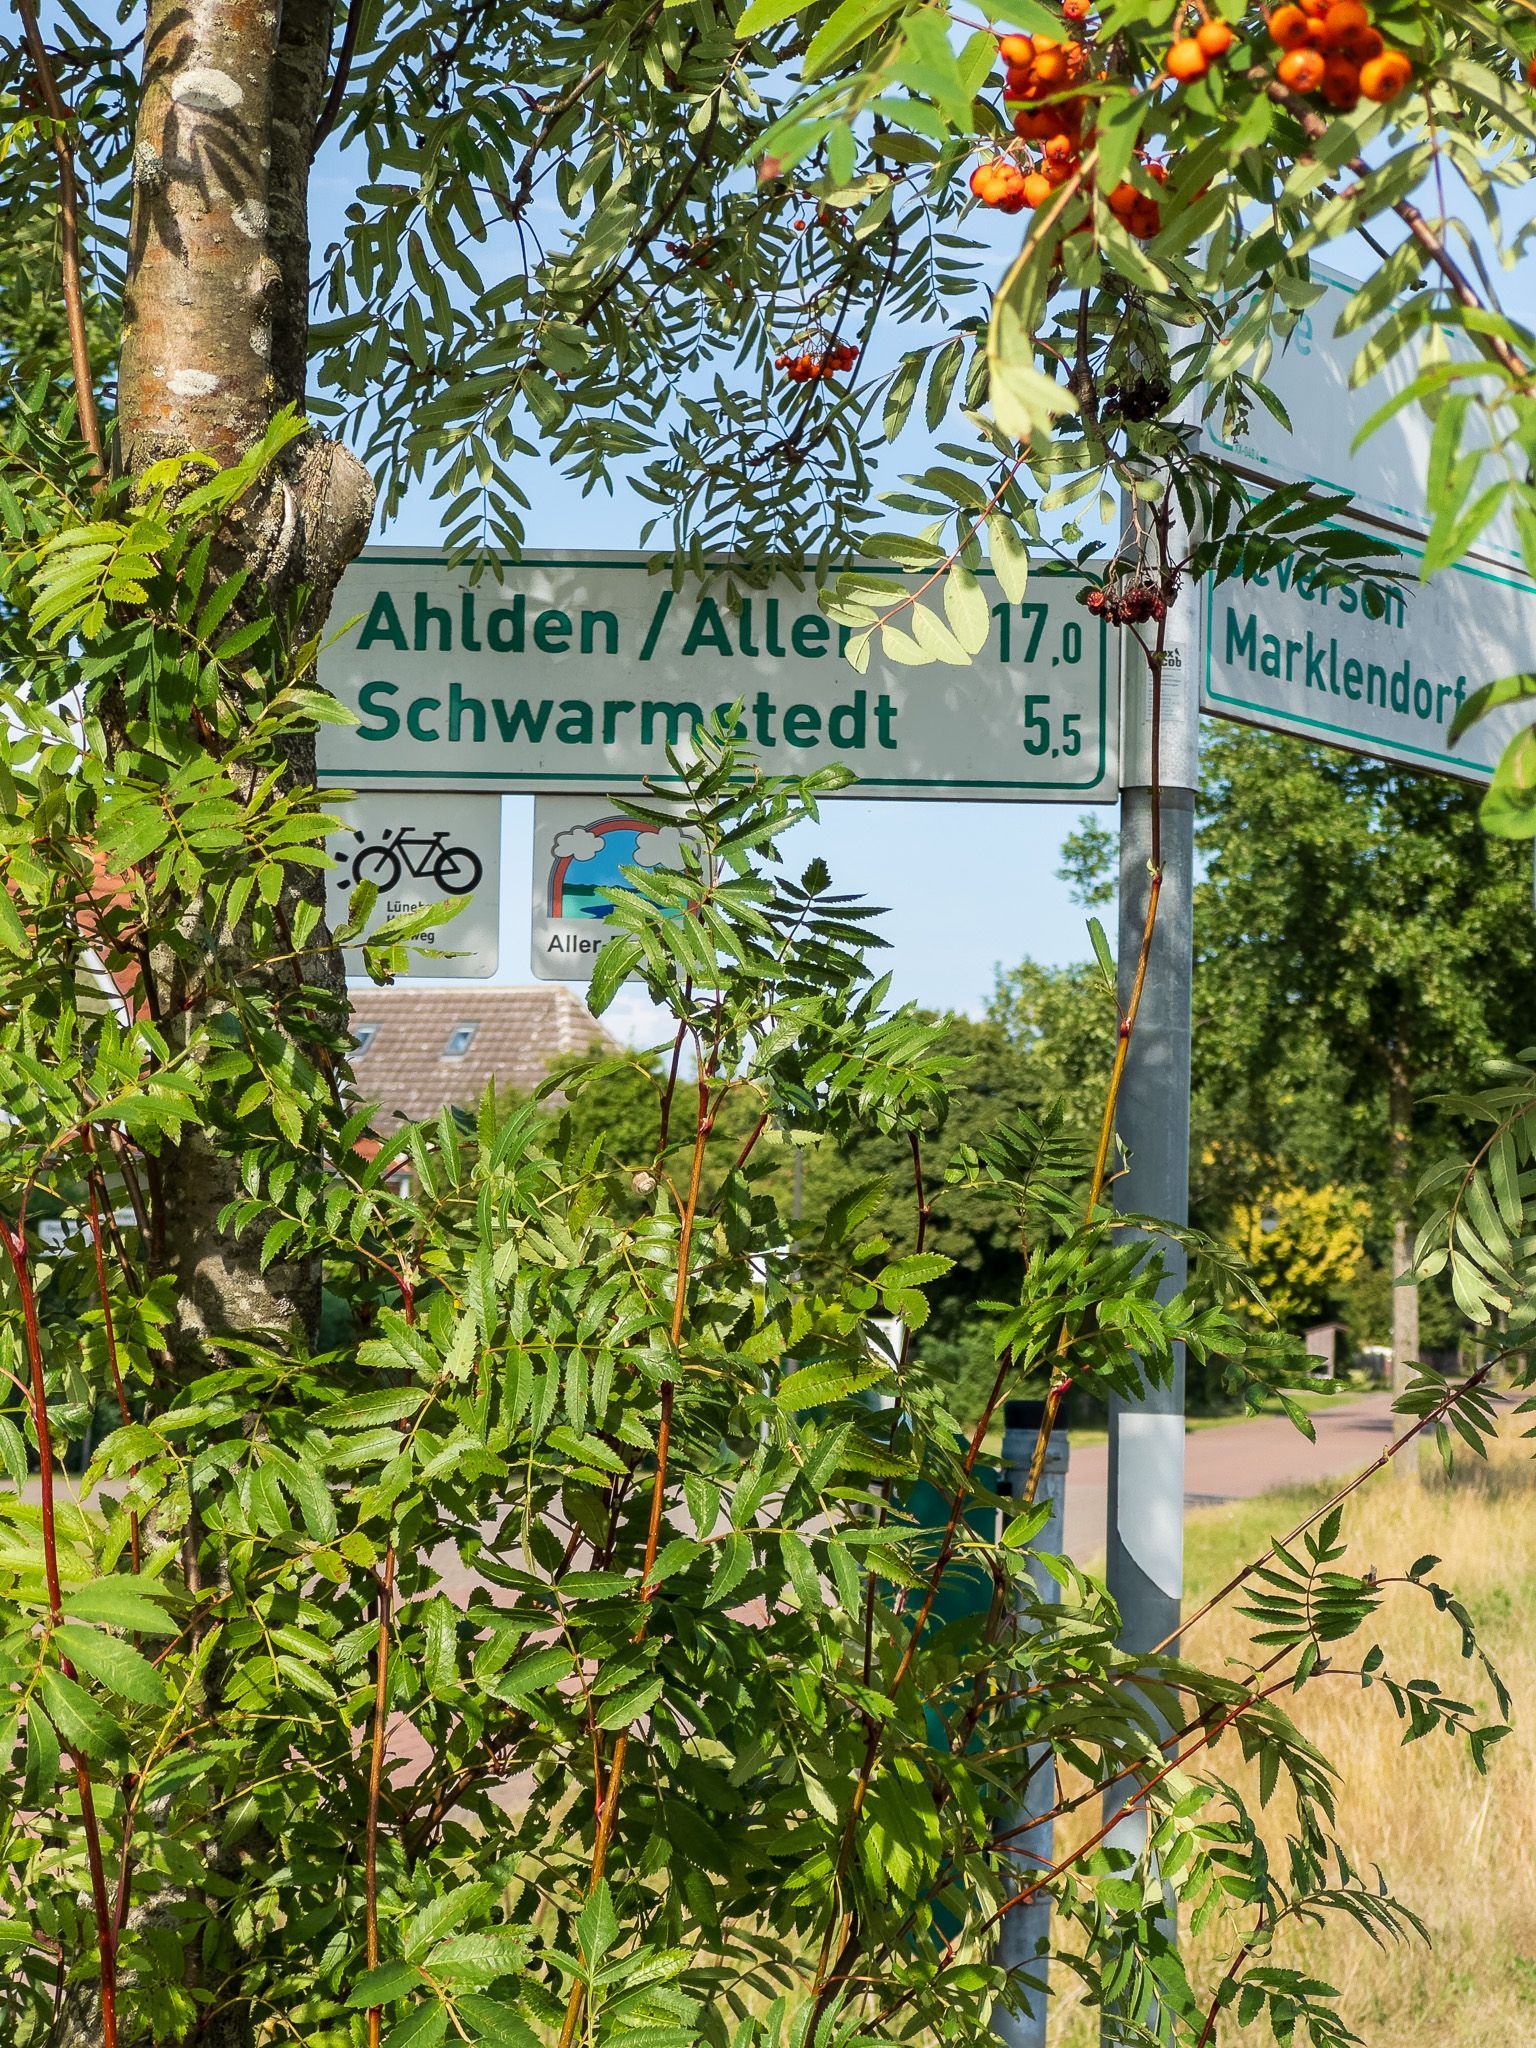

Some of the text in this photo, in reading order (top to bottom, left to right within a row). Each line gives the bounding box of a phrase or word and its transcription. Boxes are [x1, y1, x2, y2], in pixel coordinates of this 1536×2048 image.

[356, 590, 619, 655] Ahlden
[990, 602, 1082, 668] 17,0
[1225, 606, 1466, 724] Marklendorf
[355, 680, 1082, 759] Schwarmstedt 5,5
